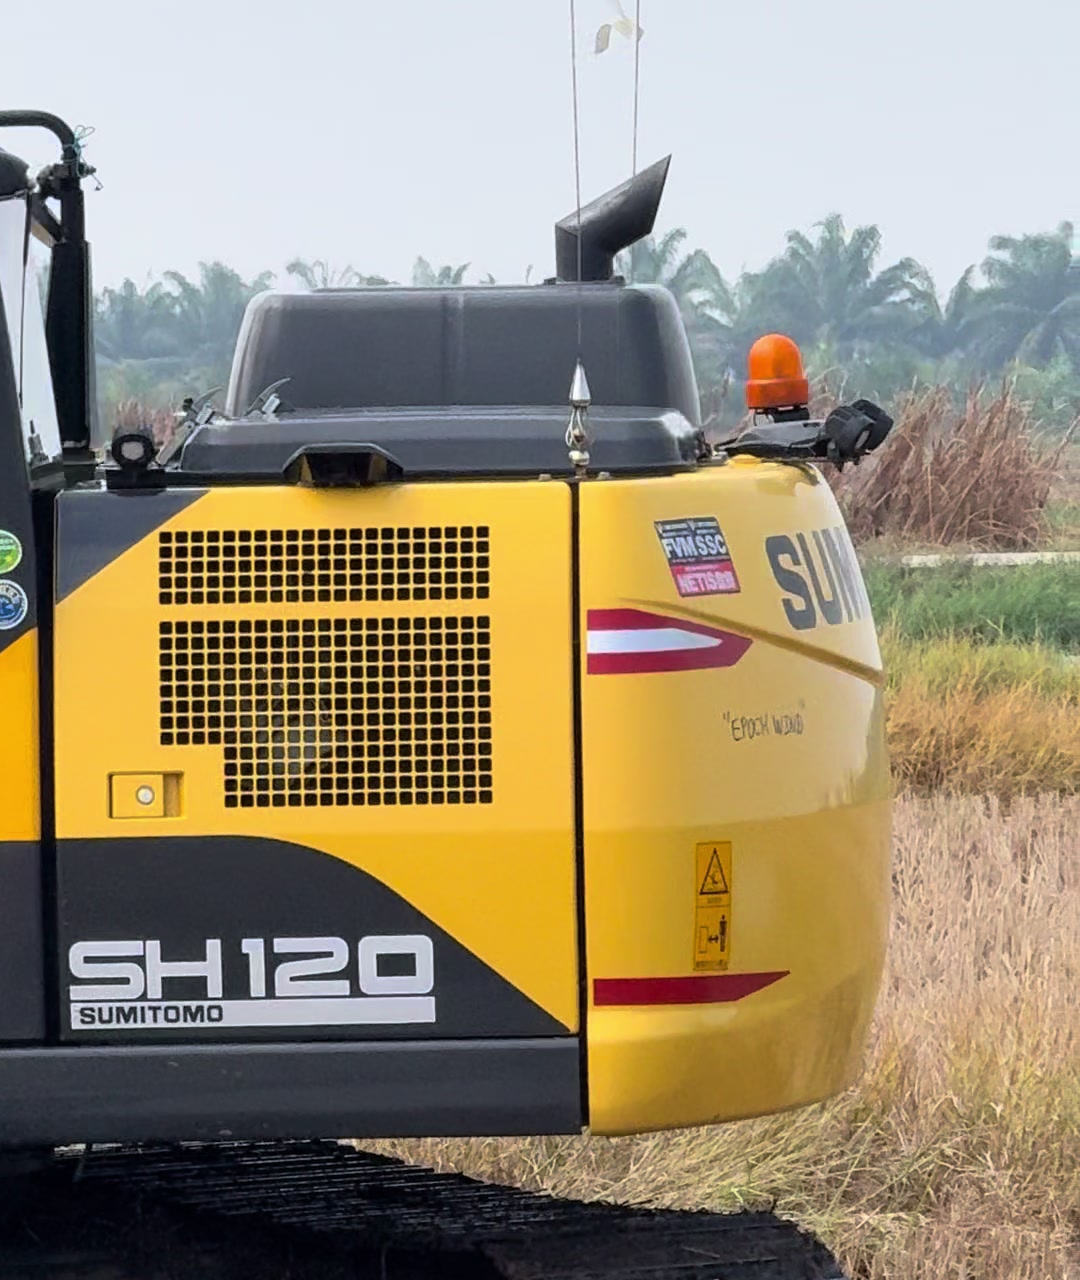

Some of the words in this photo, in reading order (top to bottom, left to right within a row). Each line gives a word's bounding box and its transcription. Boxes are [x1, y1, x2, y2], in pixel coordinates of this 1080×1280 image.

[69, 938, 222, 1001] SH
[241, 934, 435, 997] 120
[79, 1004, 224, 1025] SUMITOMO
